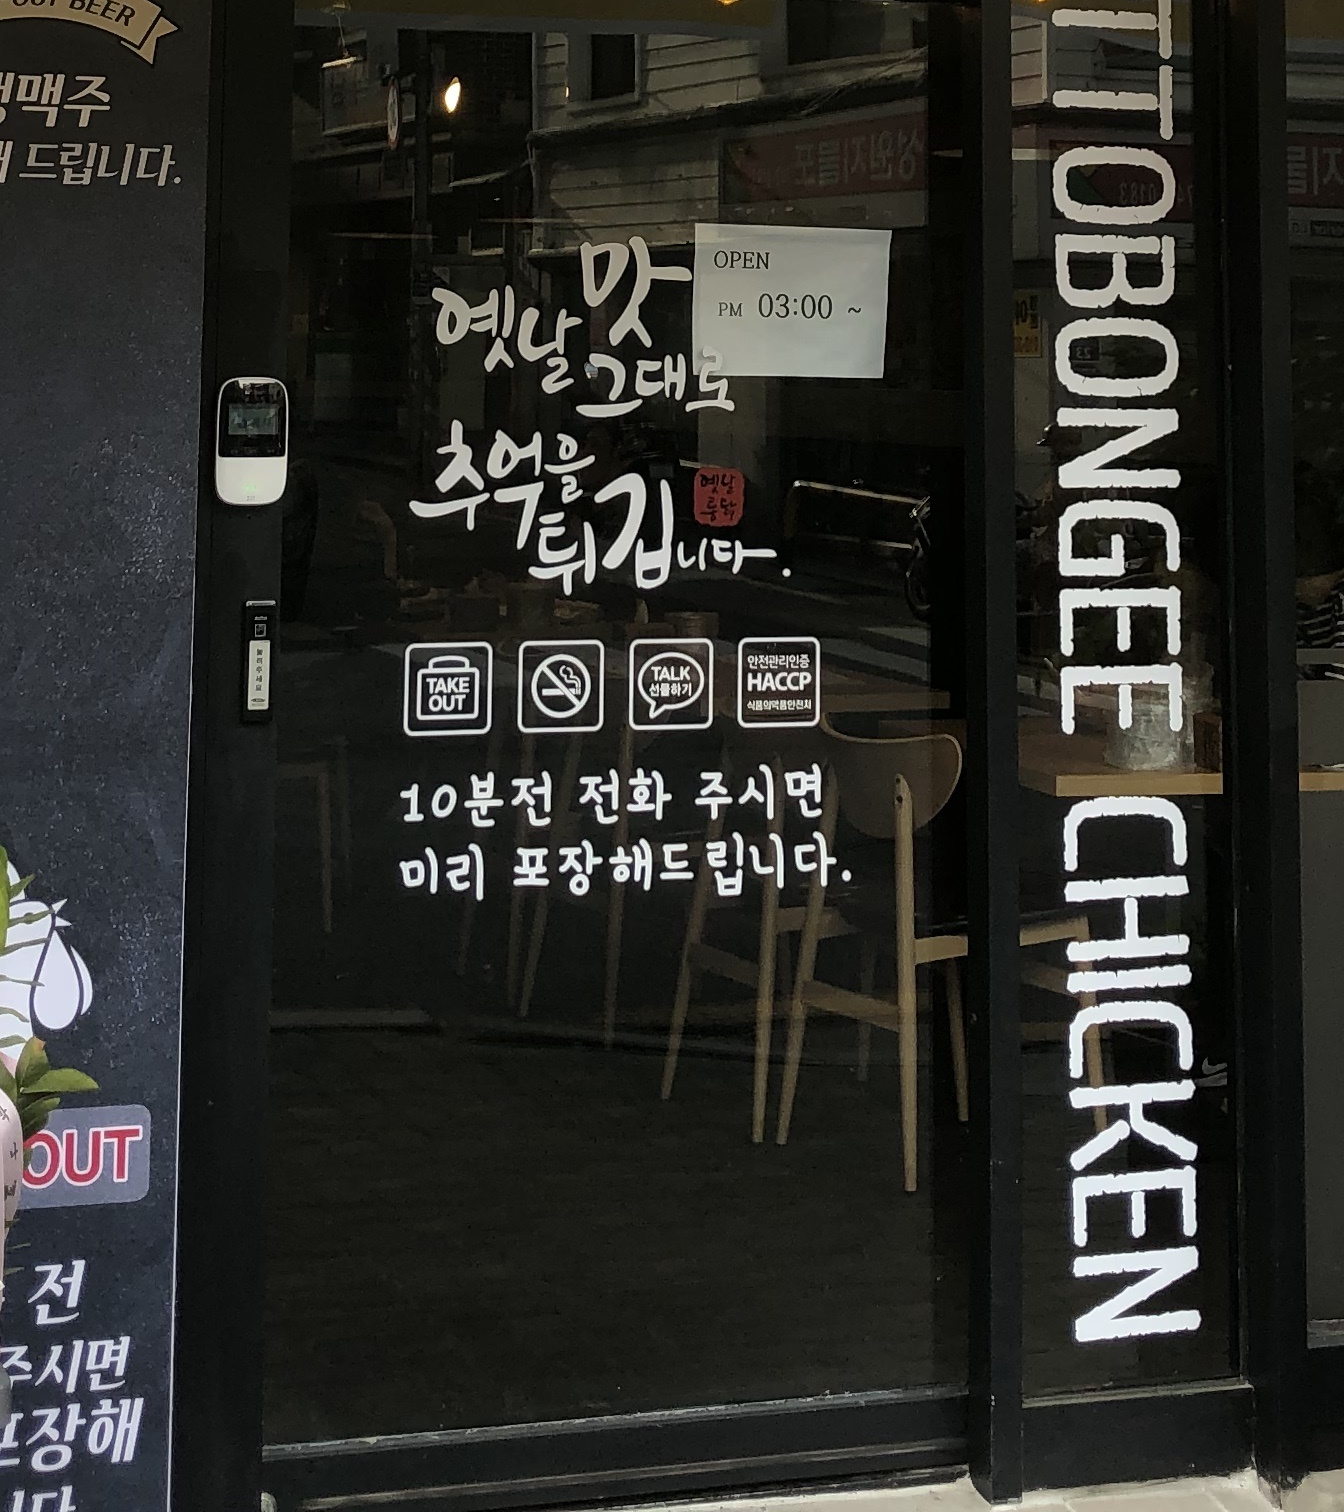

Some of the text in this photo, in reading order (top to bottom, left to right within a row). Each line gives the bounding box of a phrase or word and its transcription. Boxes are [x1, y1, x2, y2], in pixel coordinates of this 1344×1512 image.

[18, 142, 183, 187] 드립니다.
[712, 249, 771, 271] OPEN
[431, 234, 694, 395] 옛날 맛
[717, 301, 743, 319] PM
[757, 292, 834, 321] 03:00
[575, 346, 736, 418] 그대로
[409, 419, 597, 548] 추억을
[426, 676, 471, 695] TAKE
[651, 665, 691, 682] TALK
[747, 671, 812, 692] HACCP
[428, 694, 467, 712] OUT
[577, 766, 672, 823] 전화
[694, 762, 823, 821] 주시면
[399, 842, 486, 901] 미리
[1063, 794, 1202, 1344] CHICKEN
